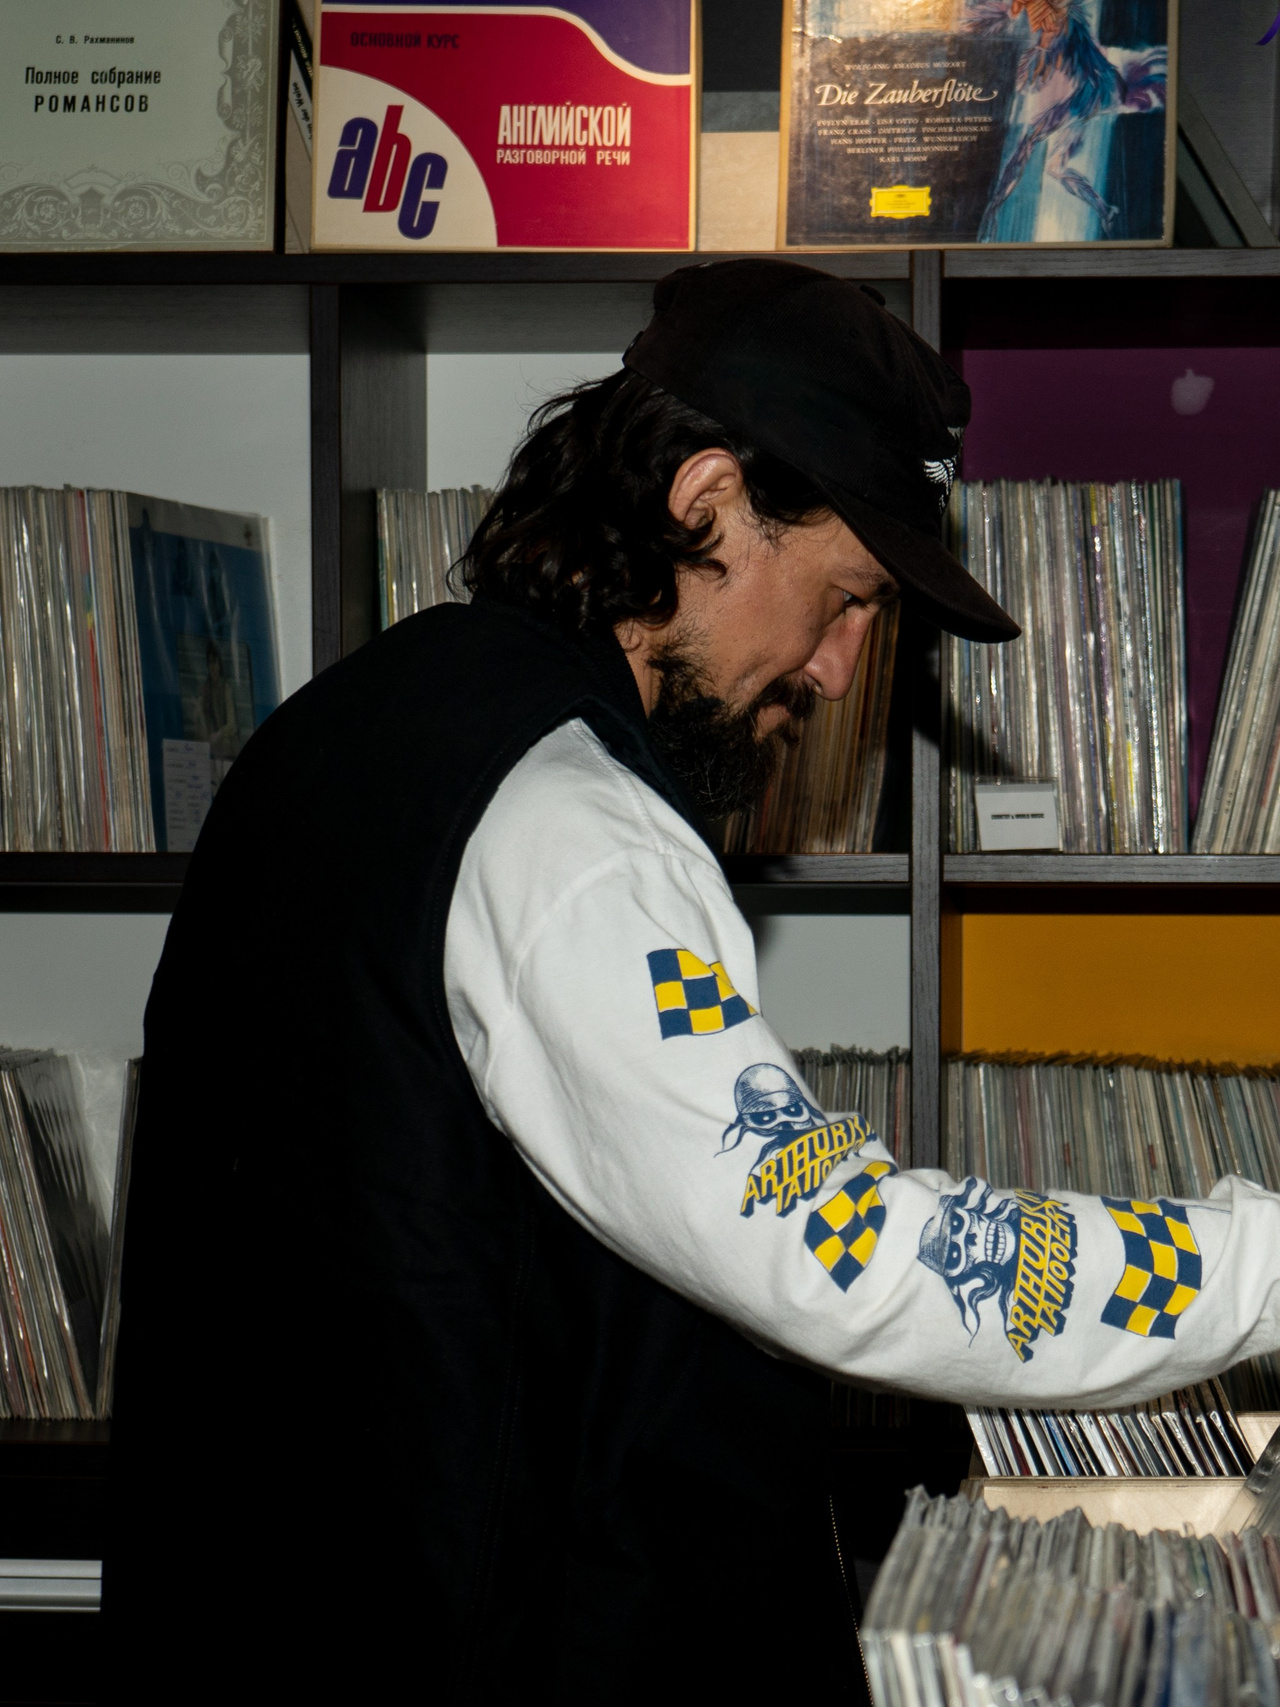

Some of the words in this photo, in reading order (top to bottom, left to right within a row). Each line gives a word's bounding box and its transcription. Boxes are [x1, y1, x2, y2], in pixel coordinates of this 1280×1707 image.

[55, 35, 63, 44] С.
[69, 35, 78, 44] В.
[84, 35, 135, 44] Рахманинов
[350, 31, 421, 48] ОСНОВНОЙ
[427, 34, 460, 48] КУРС
[25, 67, 79, 84] Полное
[91, 67, 161, 88] собрание
[814, 82, 859, 107] Die
[863, 77, 999, 109] Zauberflöte
[34, 94, 149, 112] РОМАНСОВ
[498, 101, 631, 147] АНГЛИЙСКОЙ
[496, 147, 587, 165] РАЗГОВОРНОЙ
[596, 150, 630, 165] РЕЧИ
[327, 105, 448, 240] abc
